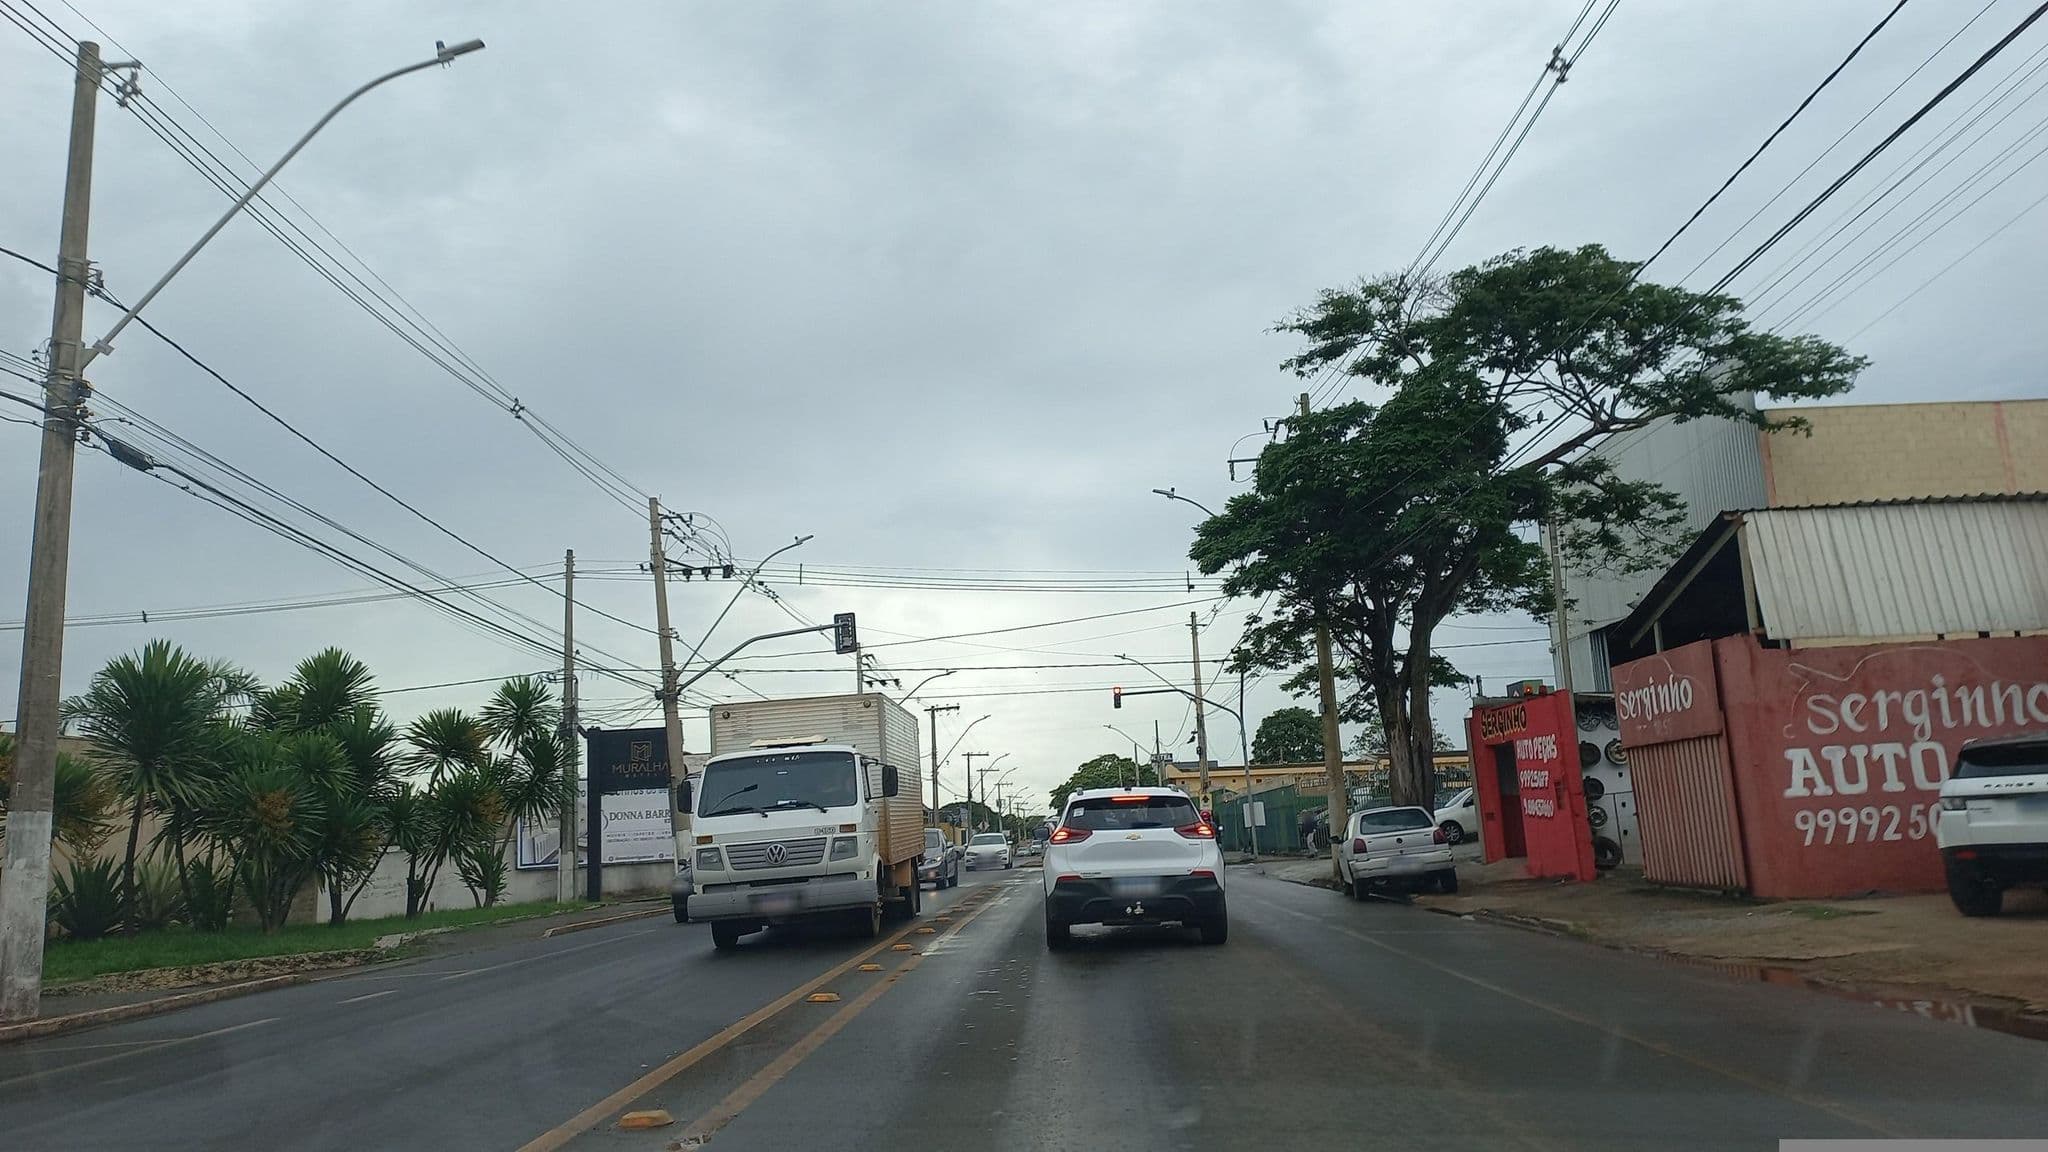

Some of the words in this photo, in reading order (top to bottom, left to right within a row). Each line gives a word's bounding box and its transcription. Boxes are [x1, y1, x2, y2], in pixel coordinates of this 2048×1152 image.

[1481, 704, 1527, 742] SERGINHO
[612, 762, 669, 774] MURALHA
[1784, 741, 1950, 798] AUTO
[609, 811, 643, 821] DONNA
[1794, 805, 1903, 847] 99992
